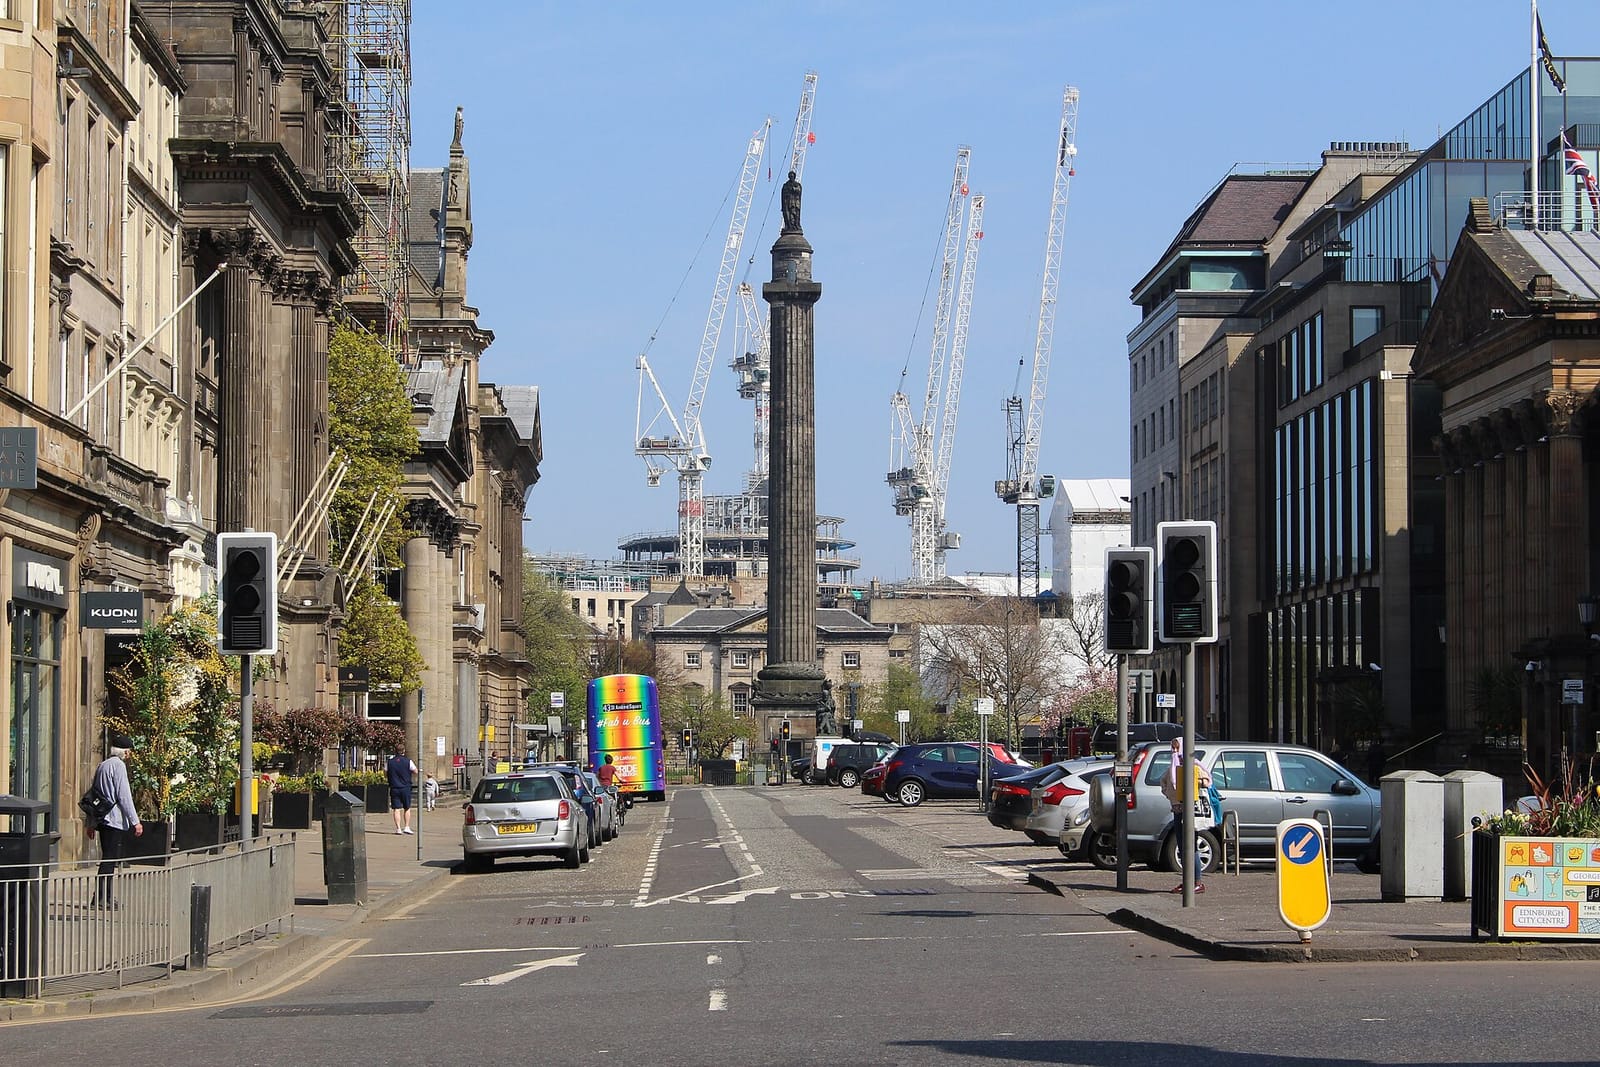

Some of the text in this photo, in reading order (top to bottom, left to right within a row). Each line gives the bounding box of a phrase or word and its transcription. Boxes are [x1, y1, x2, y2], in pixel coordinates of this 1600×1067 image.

[91, 608, 138, 617] KUONI
[633, 715, 651, 726] Bus
[1519, 909, 1564, 917] EDINBURGH
